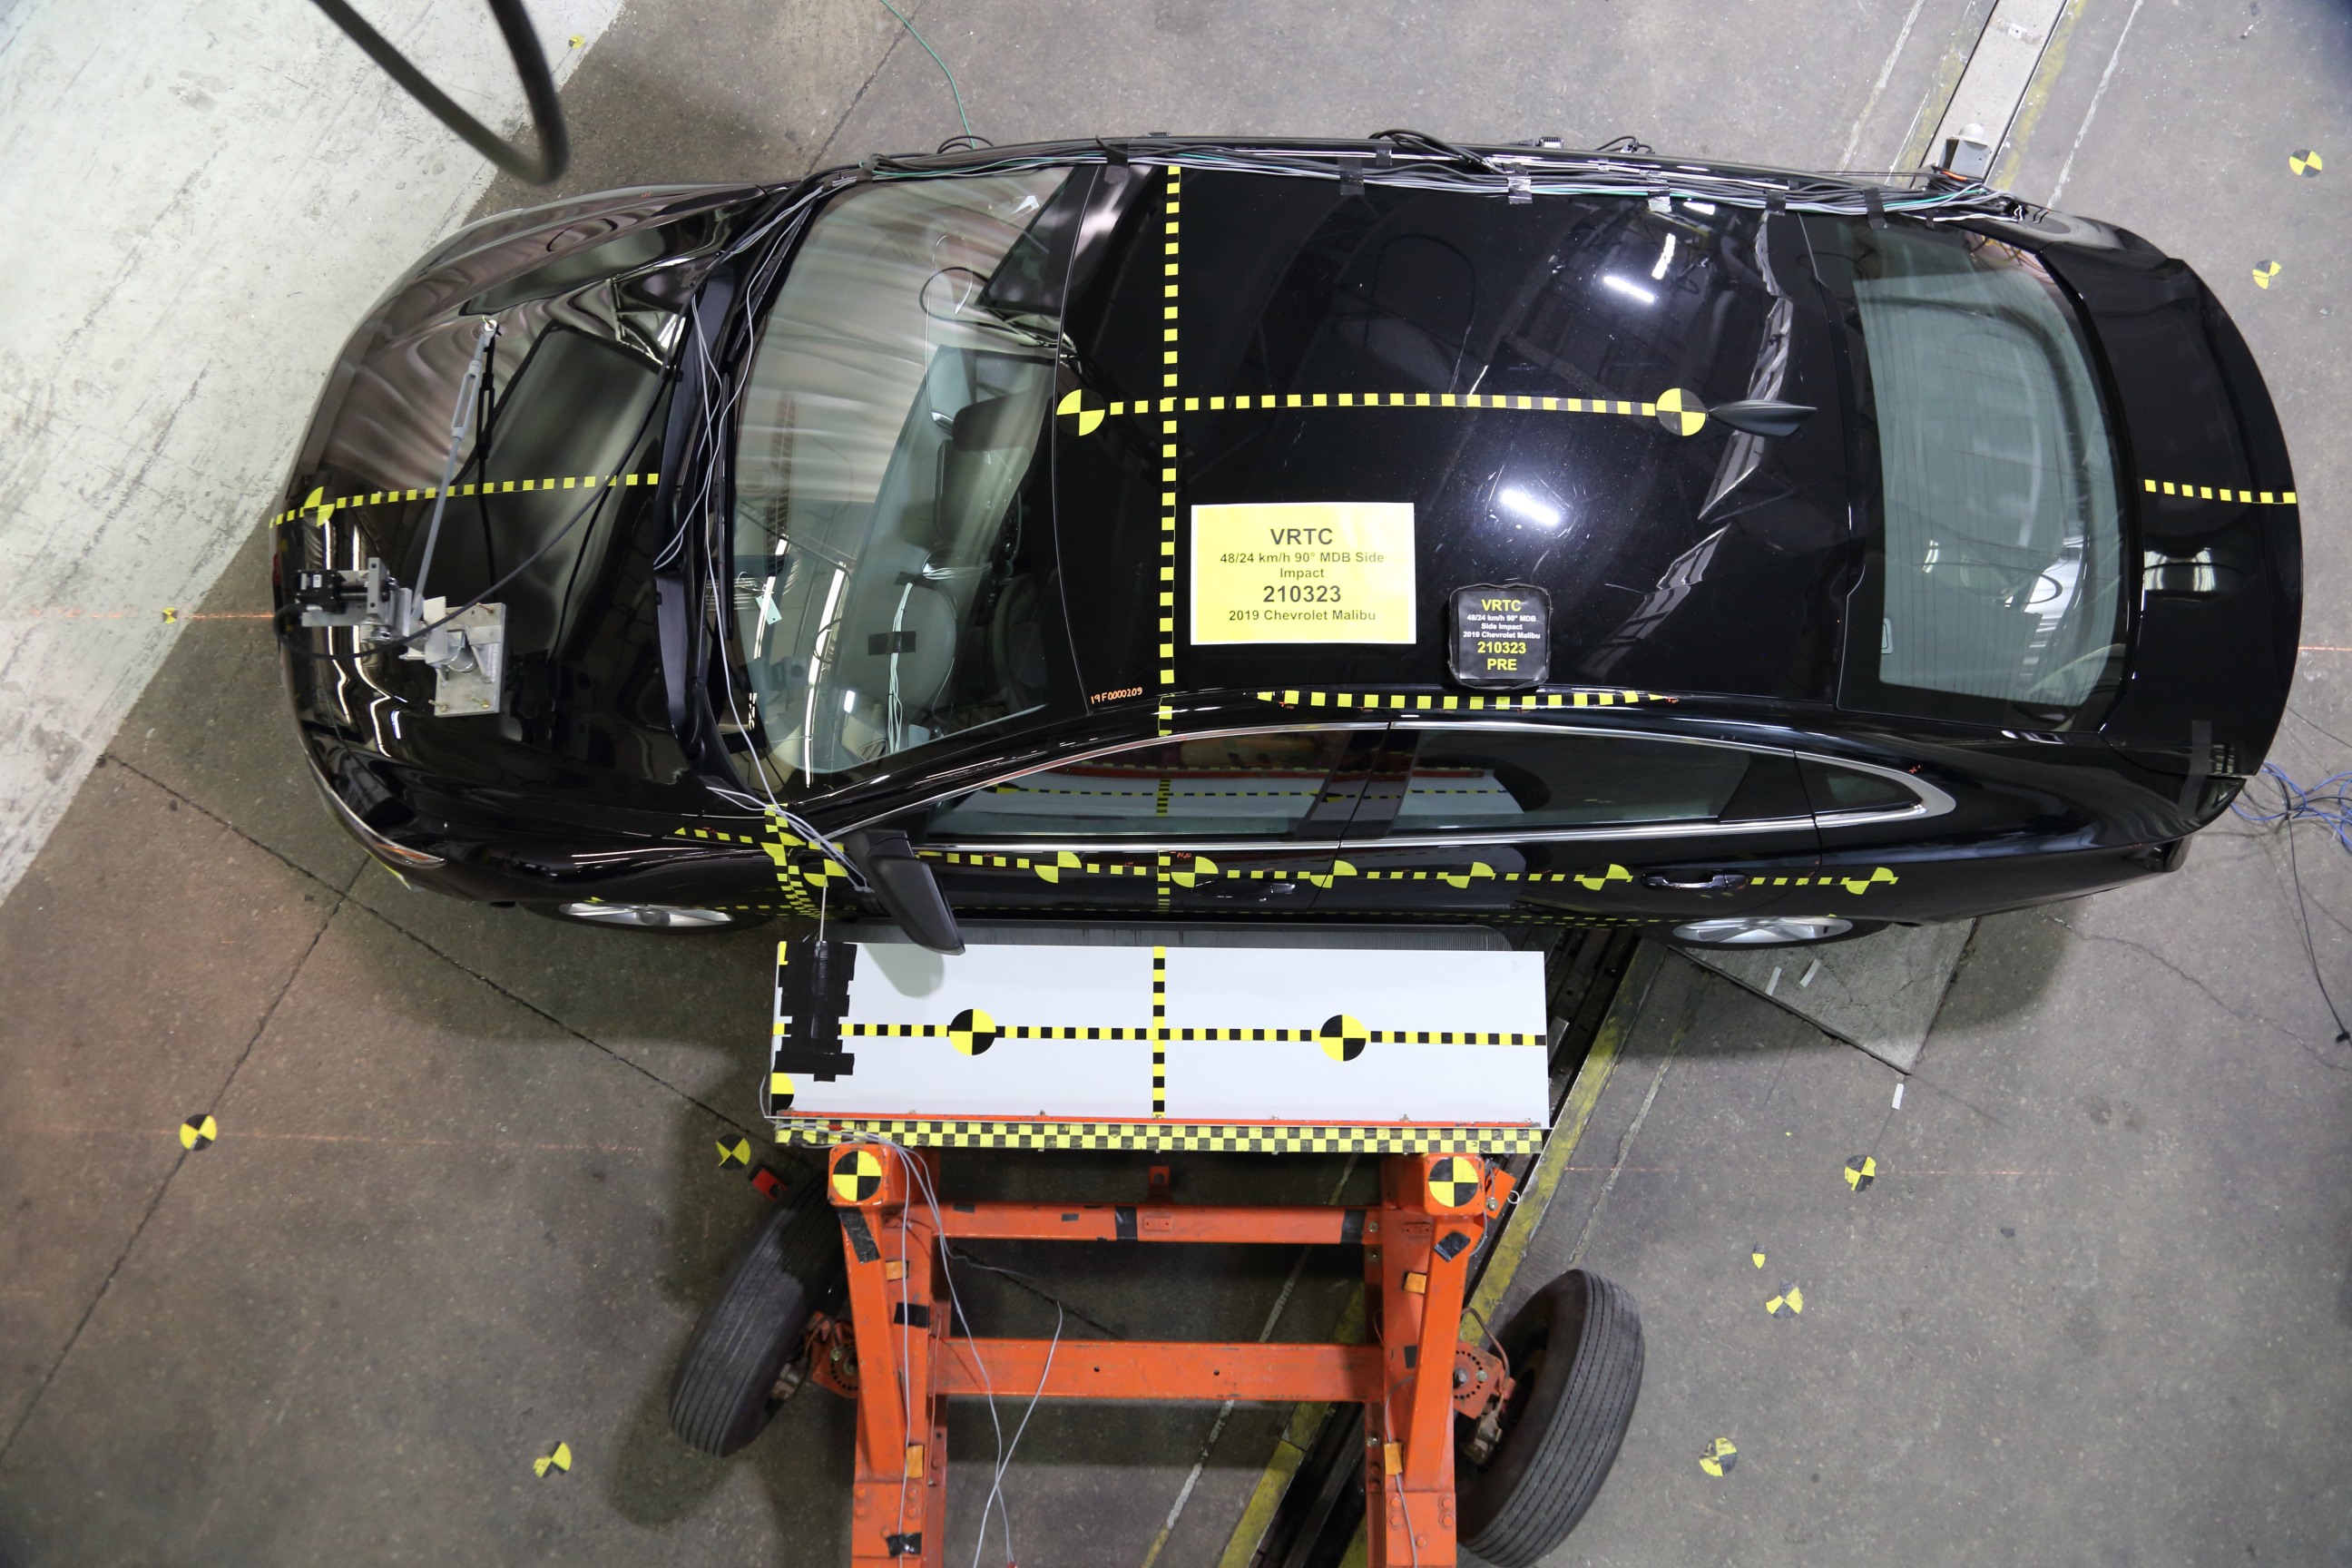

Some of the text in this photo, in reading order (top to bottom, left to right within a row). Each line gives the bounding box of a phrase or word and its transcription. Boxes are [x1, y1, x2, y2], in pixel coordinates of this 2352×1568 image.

[1270, 528, 1333, 545] VRTC
[1220, 552, 1384, 564] 48/24 km/h 90° MDB Side
[1279, 568, 1325, 580] Impact
[1263, 585, 1341, 603] 210323
[1481, 599, 1522, 612] VRTC
[1229, 610, 1376, 621] 2019 Chevrolet Malibu
[1481, 631, 1516, 639] Chevrolet
[1477, 642, 1526, 653] 210323
[1487, 658, 1517, 671] PRE
